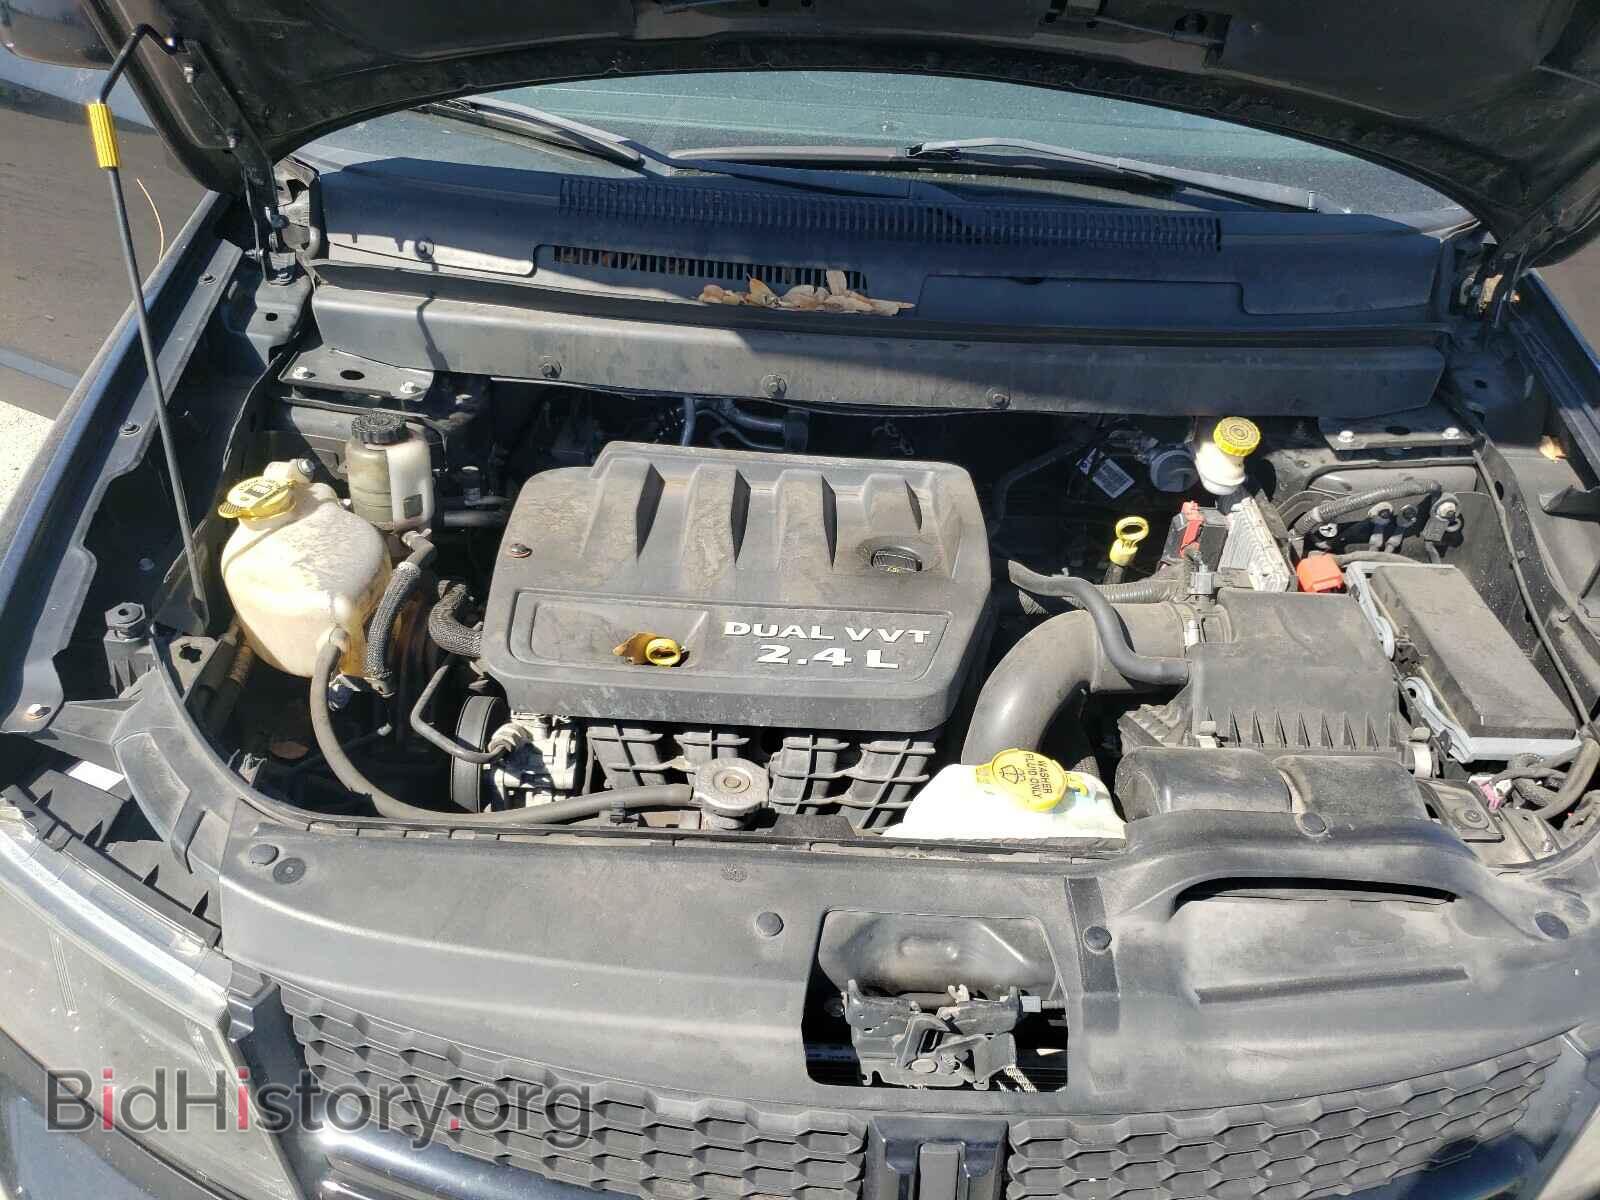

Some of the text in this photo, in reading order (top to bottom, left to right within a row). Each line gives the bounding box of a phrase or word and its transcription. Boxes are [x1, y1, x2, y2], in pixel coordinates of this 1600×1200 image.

[723, 621, 931, 644] DUAL VVT
[1024, 753, 1041, 799] FLUID ONLY
[1037, 760, 1053, 794] WASHER
